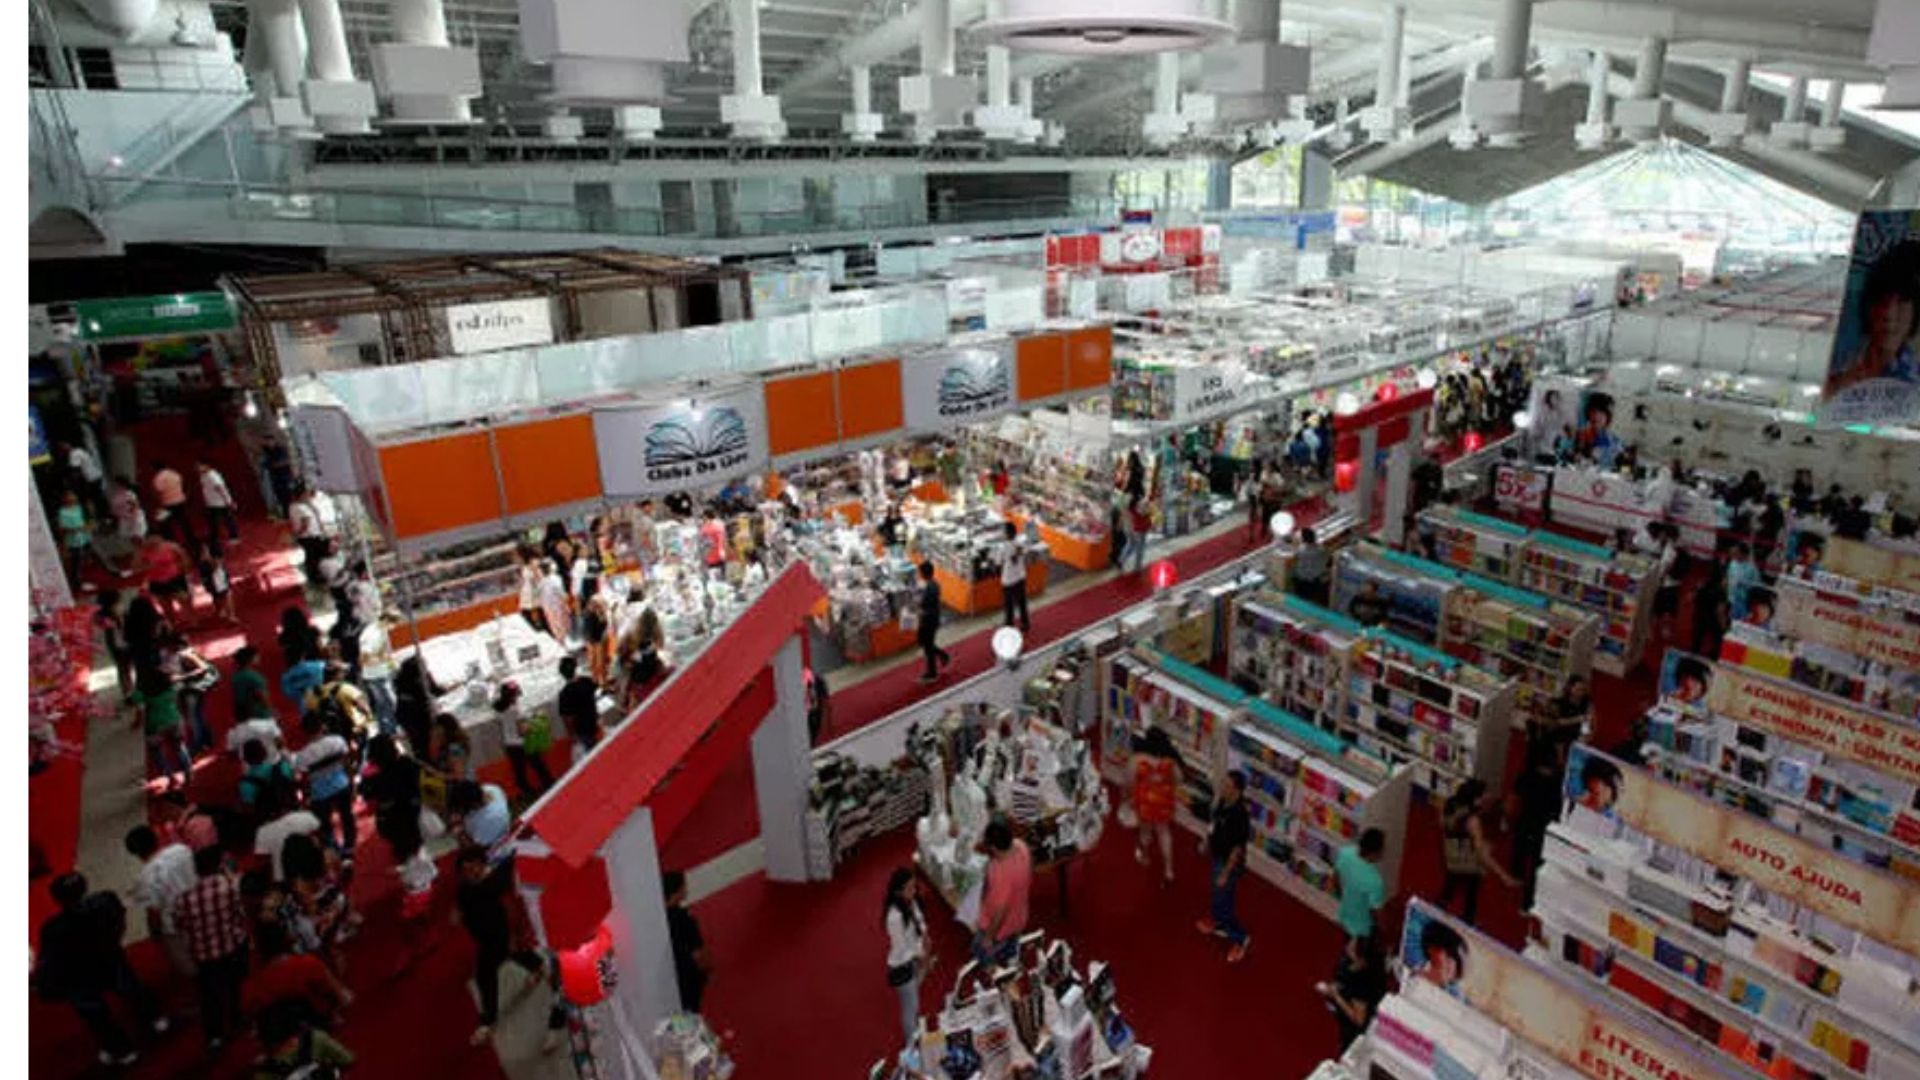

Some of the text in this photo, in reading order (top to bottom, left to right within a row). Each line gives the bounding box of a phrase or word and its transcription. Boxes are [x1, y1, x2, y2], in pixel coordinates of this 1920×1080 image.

[647, 466, 691, 481] Clube
[696, 460, 717, 474] Do
[1750, 706, 1837, 745] ECONOMIA
[1730, 837, 1863, 906] AUTO AJUDA
